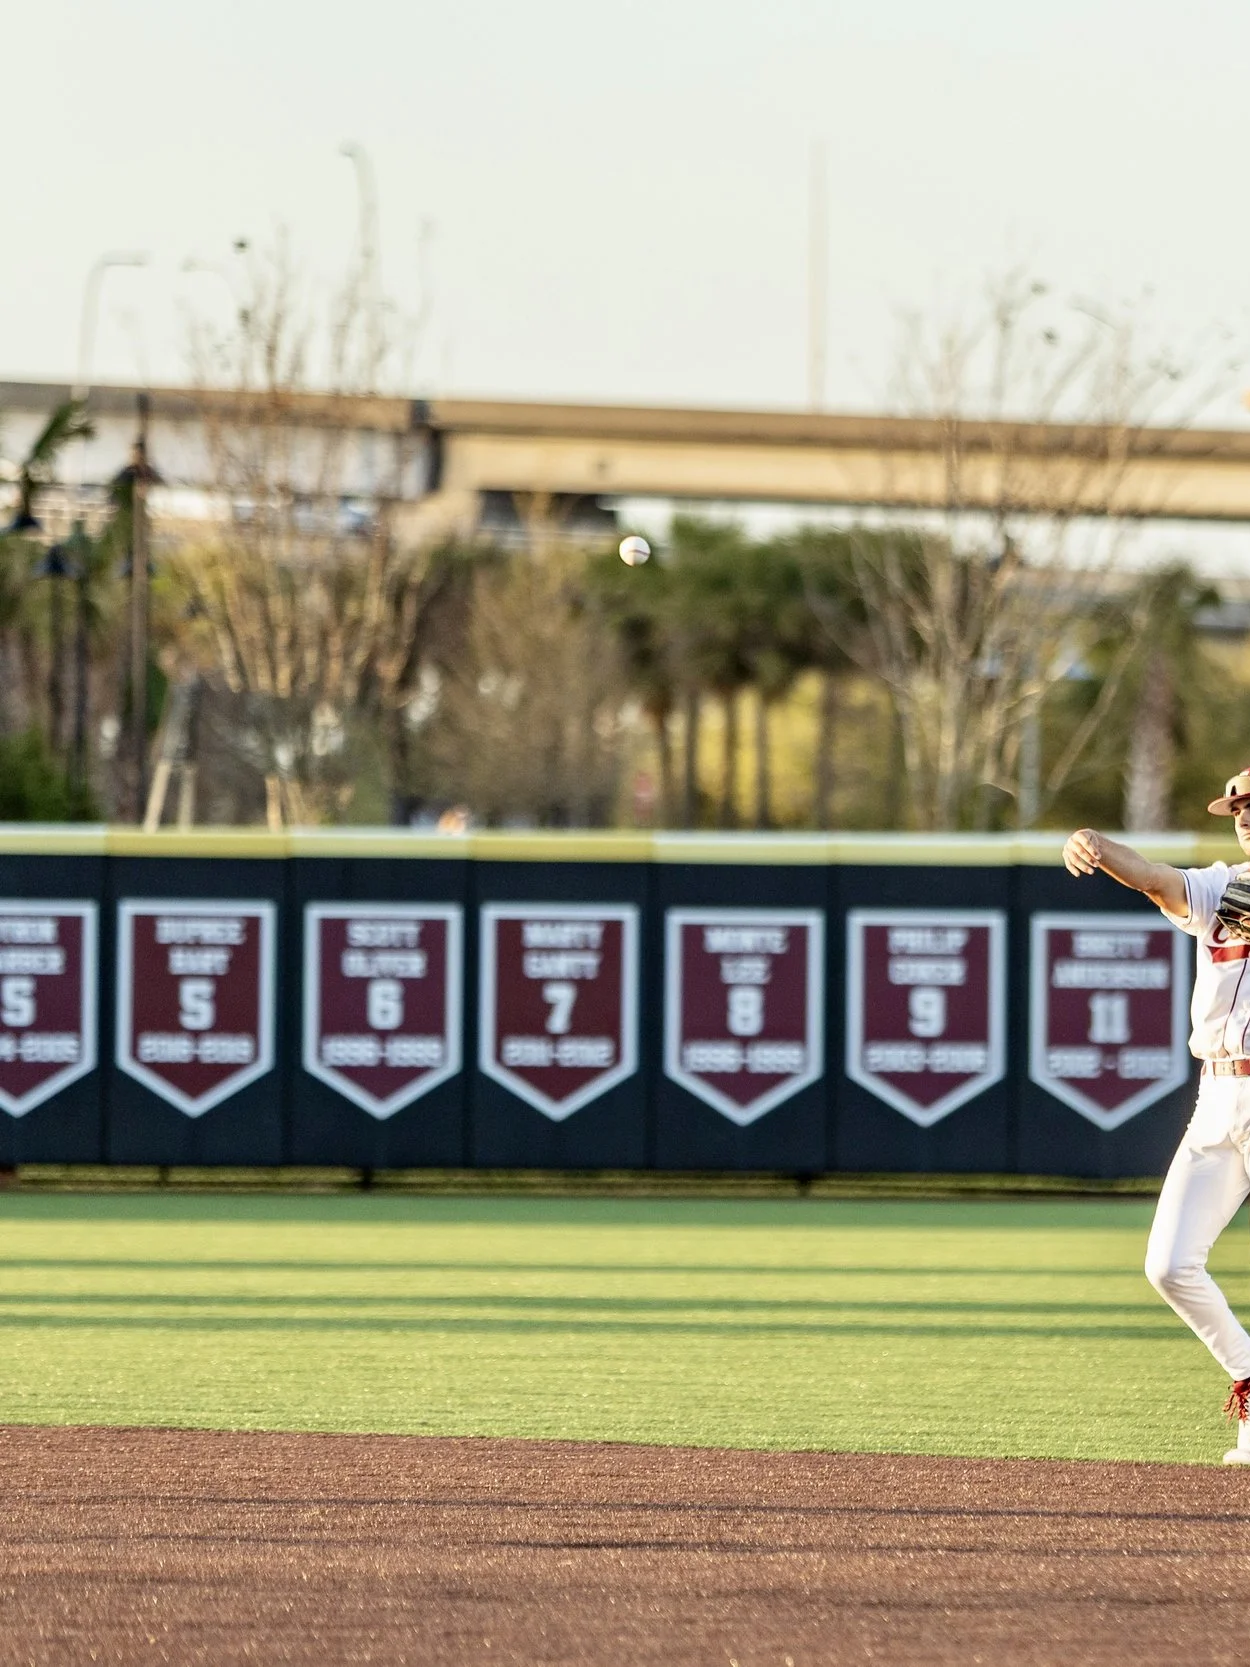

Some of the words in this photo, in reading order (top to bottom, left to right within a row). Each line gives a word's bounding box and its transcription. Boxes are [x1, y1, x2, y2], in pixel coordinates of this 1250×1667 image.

[0, 975, 37, 1027] 5
[179, 977, 216, 1030] 5
[367, 978, 404, 1030] 6
[543, 980, 578, 1034] 7
[727, 984, 764, 1036] 8
[909, 986, 946, 1038] 9
[1088, 992, 1131, 1044] 11
